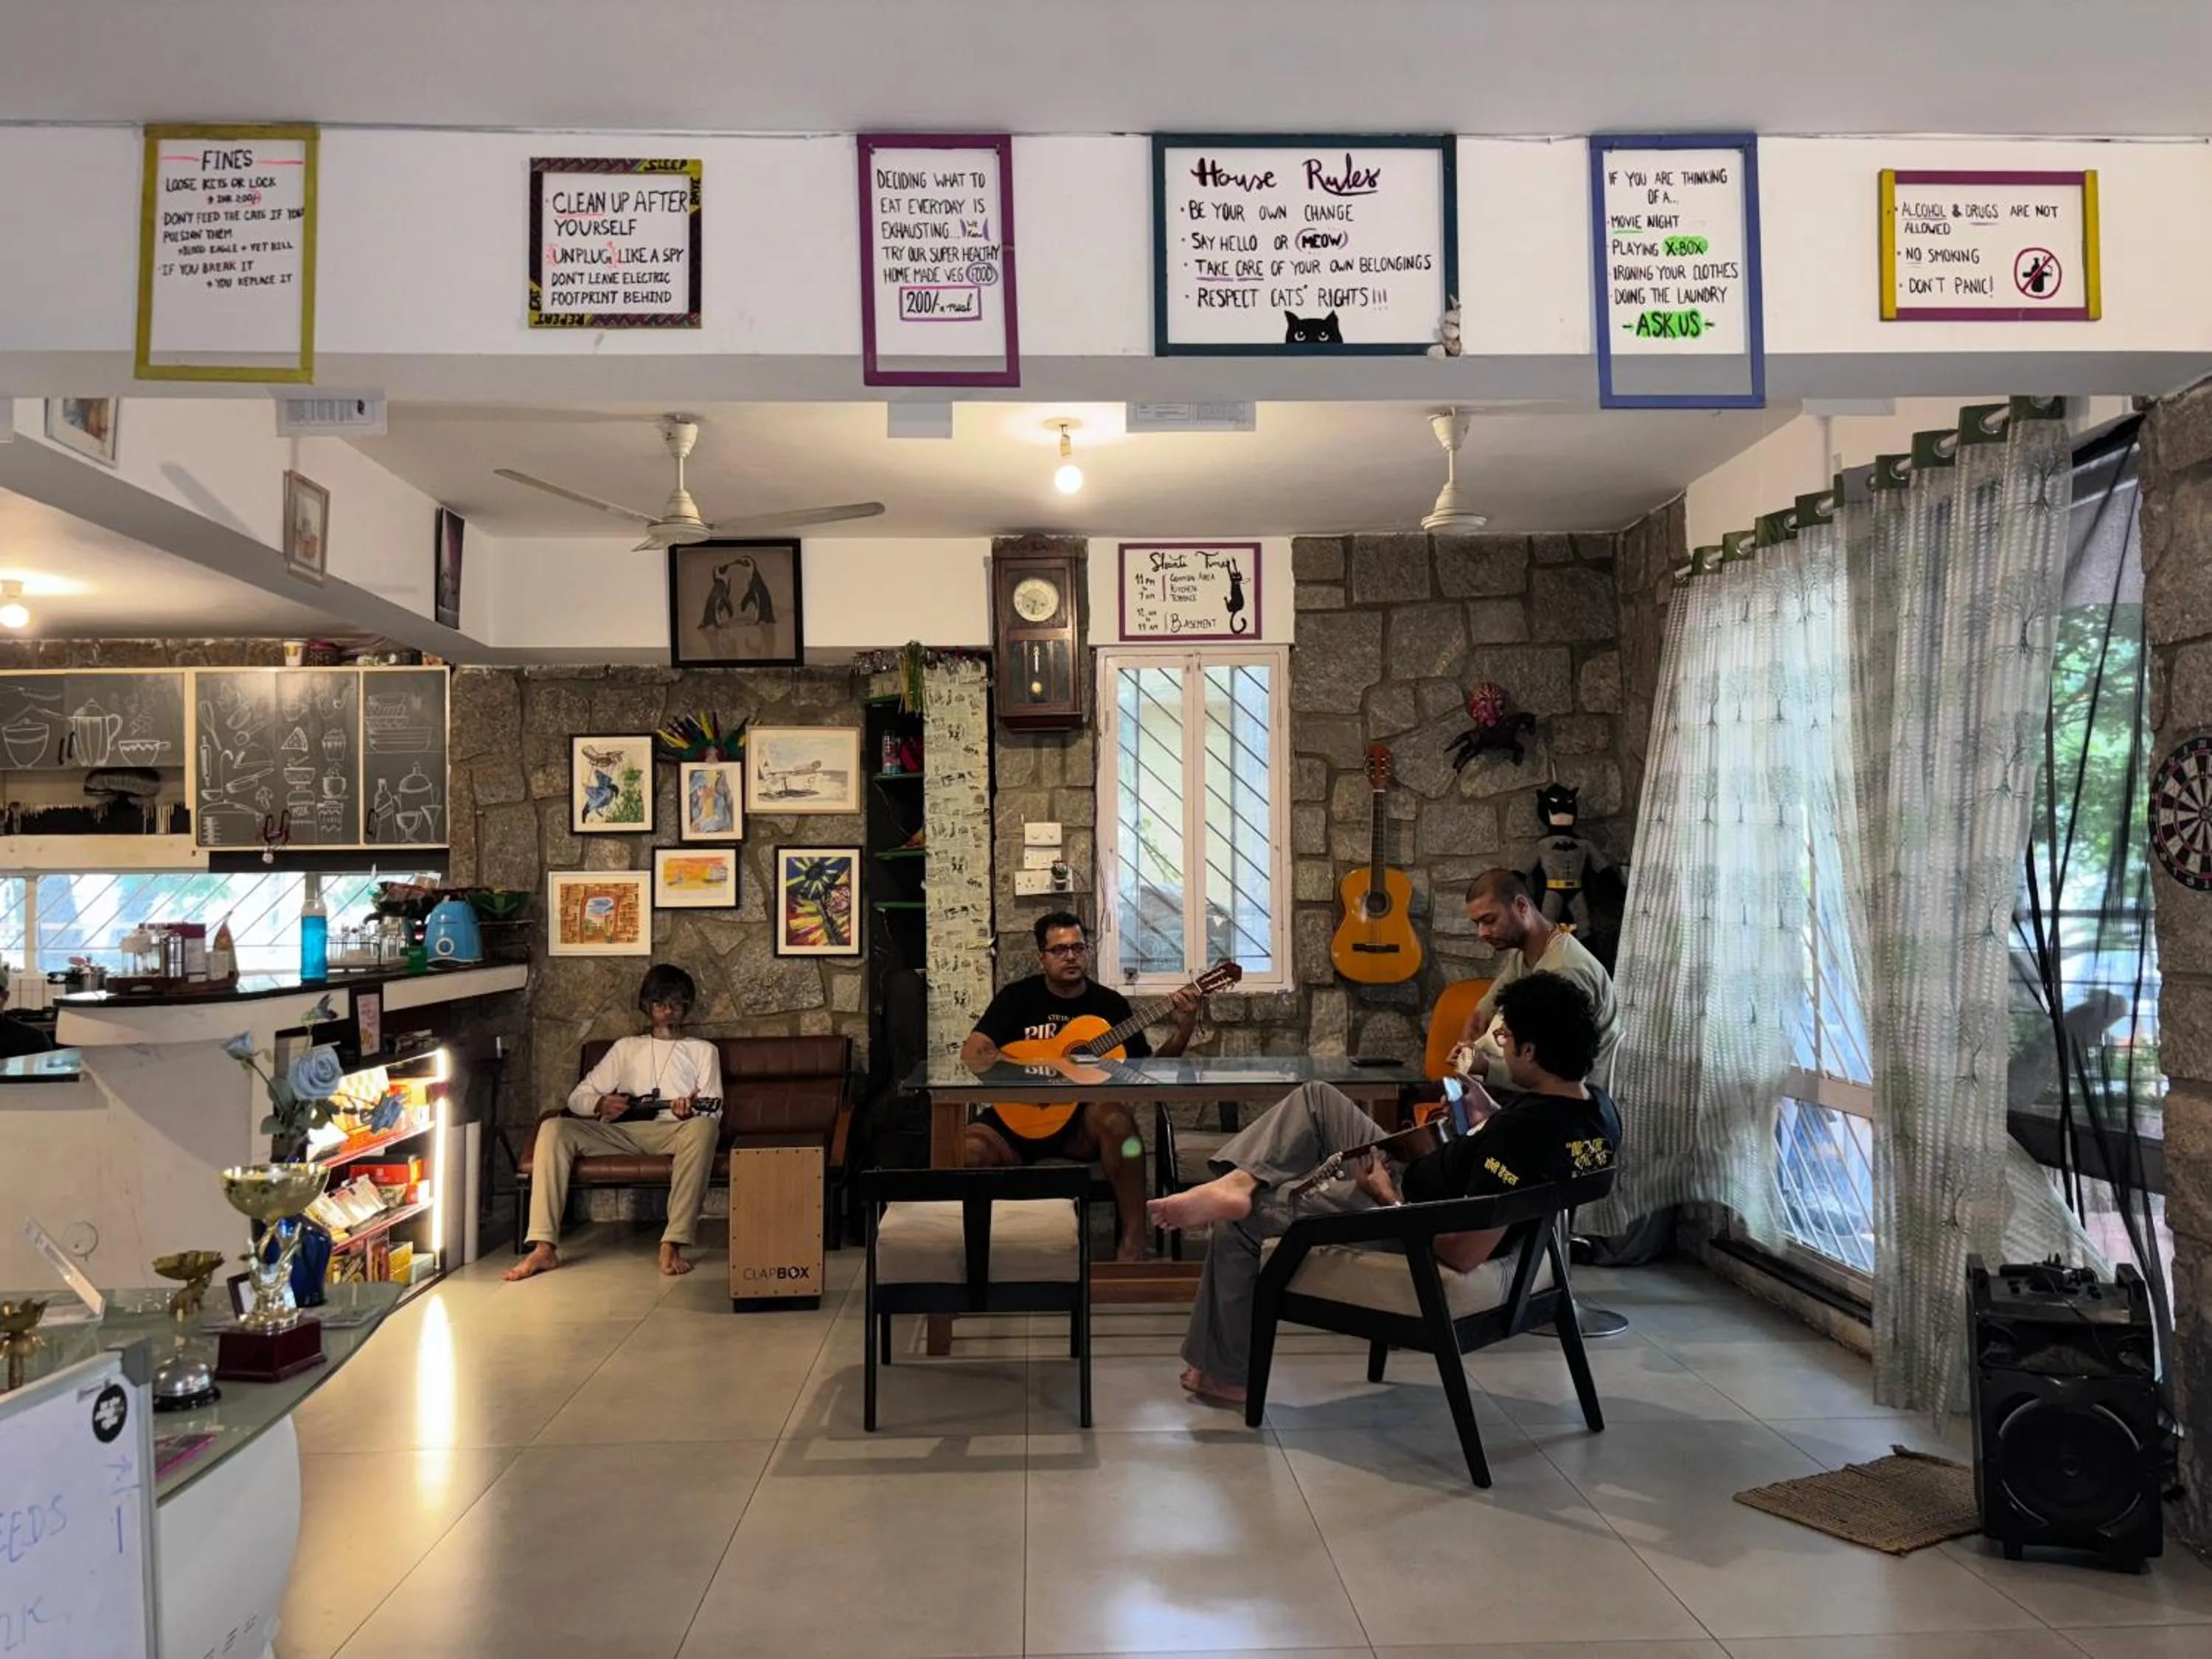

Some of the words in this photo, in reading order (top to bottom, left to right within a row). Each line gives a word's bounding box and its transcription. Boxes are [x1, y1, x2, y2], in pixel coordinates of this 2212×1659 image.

[201, 150, 253, 171] FINES
[644, 159, 688, 170] SLEEP
[877, 168, 927, 189] DECIDING
[933, 173, 965, 187] WHAT
[970, 173, 985, 188] TO
[1190, 157, 1277, 192] House
[1302, 153, 1380, 192] Rules
[1609, 172, 1618, 185] IF
[1625, 172, 1647, 188] YOU
[1655, 172, 1674, 185] ARE
[1681, 169, 1728, 184] THINKING
[166, 178, 196, 192] LOOSE
[231, 178, 244, 188] OR
[248, 177, 276, 188] LOCK
[553, 192, 606, 214] CLEAN
[611, 192, 630, 213] UP
[634, 191, 688, 212] AFTER
[1648, 189, 1659, 204] OF
[880, 197, 901, 213] EAT
[908, 198, 965, 215] EVERYDAY
[974, 198, 985, 213] IS
[1189, 200, 1205, 220] BE
[1211, 202, 1245, 221] YOUR
[1259, 205, 1287, 220] OWN
[1304, 204, 1354, 222] CHANGE
[1902, 202, 1947, 218] ALCOHOL
[1952, 204, 1962, 218] &
[1965, 205, 1999, 218] DRUGS
[2010, 205, 2029, 217] ARE
[2036, 206, 2059, 218] NOT
[197, 211, 220, 223] FEED
[225, 210, 239, 220] THE
[244, 209, 265, 221] CATS
[270, 209, 282, 220] IF
[1610, 215, 1642, 229] MOVIE
[1647, 215, 1680, 228] NIGHT
[206, 229, 232, 240] THEM
[554, 219, 637, 236] YOURSELF
[1905, 223, 1950, 234] ALLOWED
[1192, 232, 1214, 251] SAY
[1220, 234, 1257, 251] HELLO
[1273, 234, 1288, 251] OR
[1613, 240, 1658, 257] PLAYING
[553, 247, 612, 264] UNPLUG
[619, 247, 648, 263] LIKE
[650, 248, 659, 262] A
[663, 248, 684, 263] SPY
[881, 246, 905, 260] TRY
[908, 247, 927, 262] OUR
[930, 246, 959, 262] SUPER
[962, 245, 1000, 261] HEALTHY
[1906, 248, 1921, 261] NO
[1929, 248, 1980, 264] SMOKING
[162, 264, 174, 276] IF
[180, 263, 198, 276] YOU
[203, 262, 236, 273] BREAK
[241, 260, 254, 272] IT
[1194, 260, 1229, 276] TAKE
[1236, 260, 1264, 276] CARE
[1271, 261, 1284, 276] OF
[1290, 259, 1321, 274] YOUR
[1330, 259, 1353, 272] OWN
[1360, 254, 1432, 272] BELONGINGS
[1613, 265, 1653, 281] IRONING
[1659, 265, 1686, 279] YOUR
[1694, 262, 1738, 280] CLOTHES
[215, 277, 232, 288] YOU
[238, 275, 274, 286] REPLACE
[280, 274, 292, 282] IT
[552, 272, 585, 287] DON'T
[588, 272, 619, 284] LEAVE
[623, 272, 670, 284] ELECTRIC
[884, 266, 911, 283] HOME
[914, 267, 939, 283] MADE
[971, 266, 992, 282] FOOD
[1615, 288, 1645, 305] DOING
[1651, 288, 1670, 303] THE
[1677, 286, 1728, 304] LAUNDRY
[1909, 277, 1945, 293] DON'T
[1955, 276, 1993, 298] PANIC!
[552, 291, 619, 307] FOOTPRINT
[623, 291, 672, 304] BEHIND
[1197, 288, 1259, 308] RESPECT
[535, 313, 584, 324] REPEAT
[1024, 1022, 1057, 1040] PIR
[743, 1267, 810, 1280] CLAPBOX
